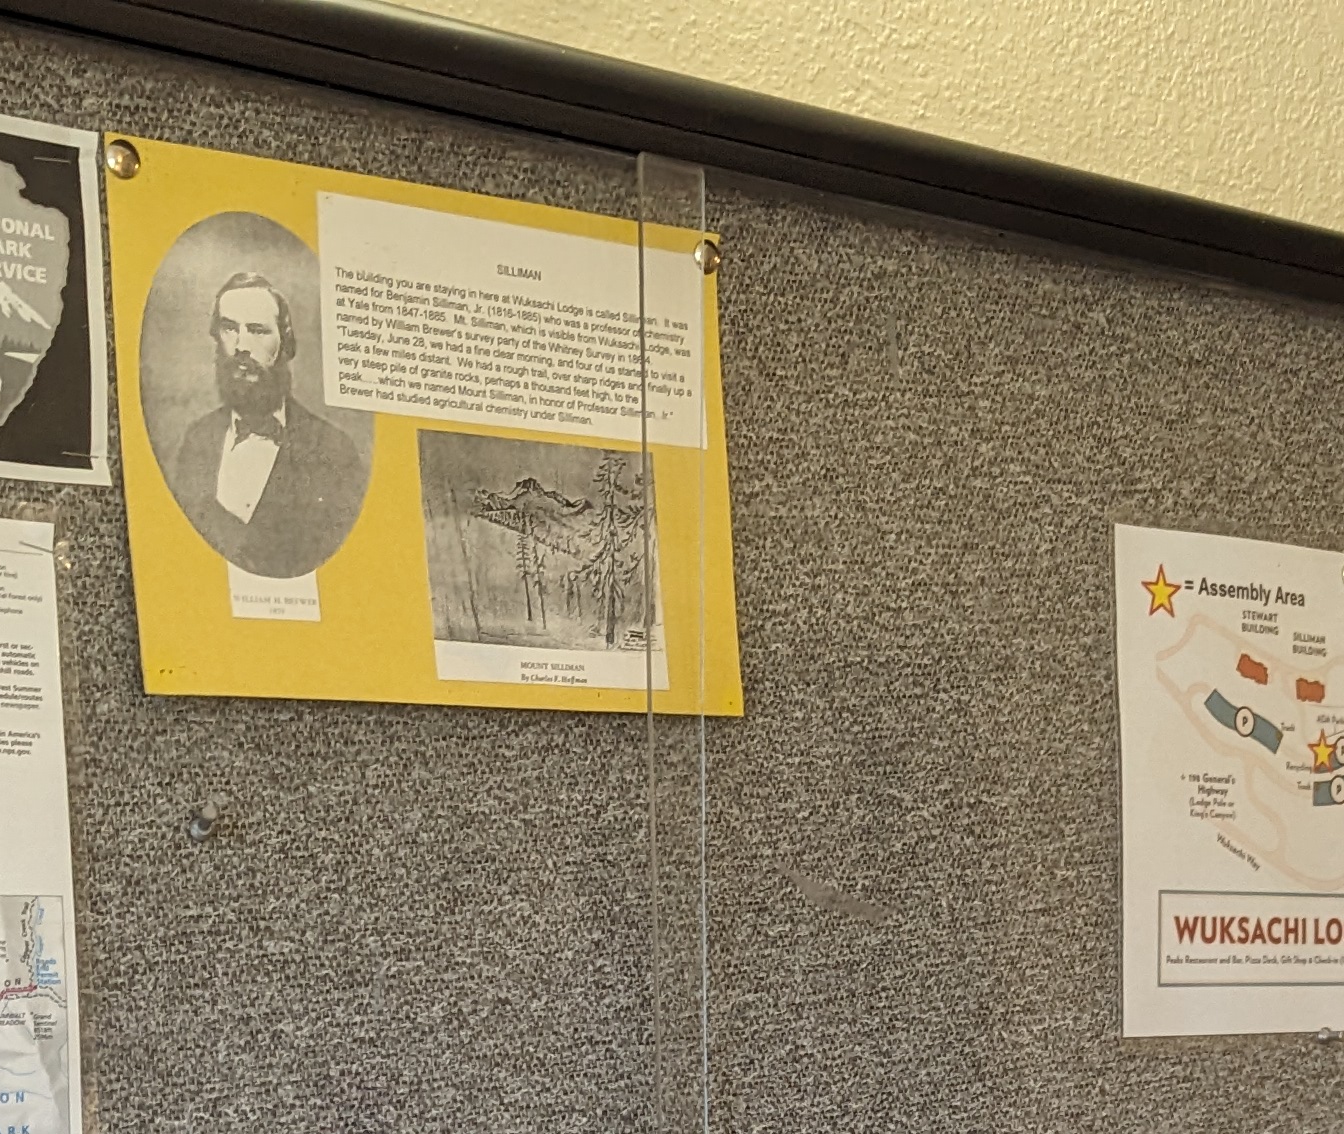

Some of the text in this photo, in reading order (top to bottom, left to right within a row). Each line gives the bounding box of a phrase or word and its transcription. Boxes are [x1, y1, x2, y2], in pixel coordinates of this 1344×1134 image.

[497, 264, 542, 281] SILLIMAN
[335, 266, 620, 321] The building you are staying in here at Wuksachi Lodge is called
[336, 283, 430, 306] named for Benjamin
[339, 384, 394, 401] Brewer had
[1198, 577, 1305, 607] Assembly Area
[1242, 611, 1278, 623] STEWART
[1242, 623, 1279, 636] BUILDING
[1293, 632, 1326, 644] SILLIMAN
[1293, 645, 1326, 657] BUILDING
[1174, 916, 1306, 944] WUKSACHI
